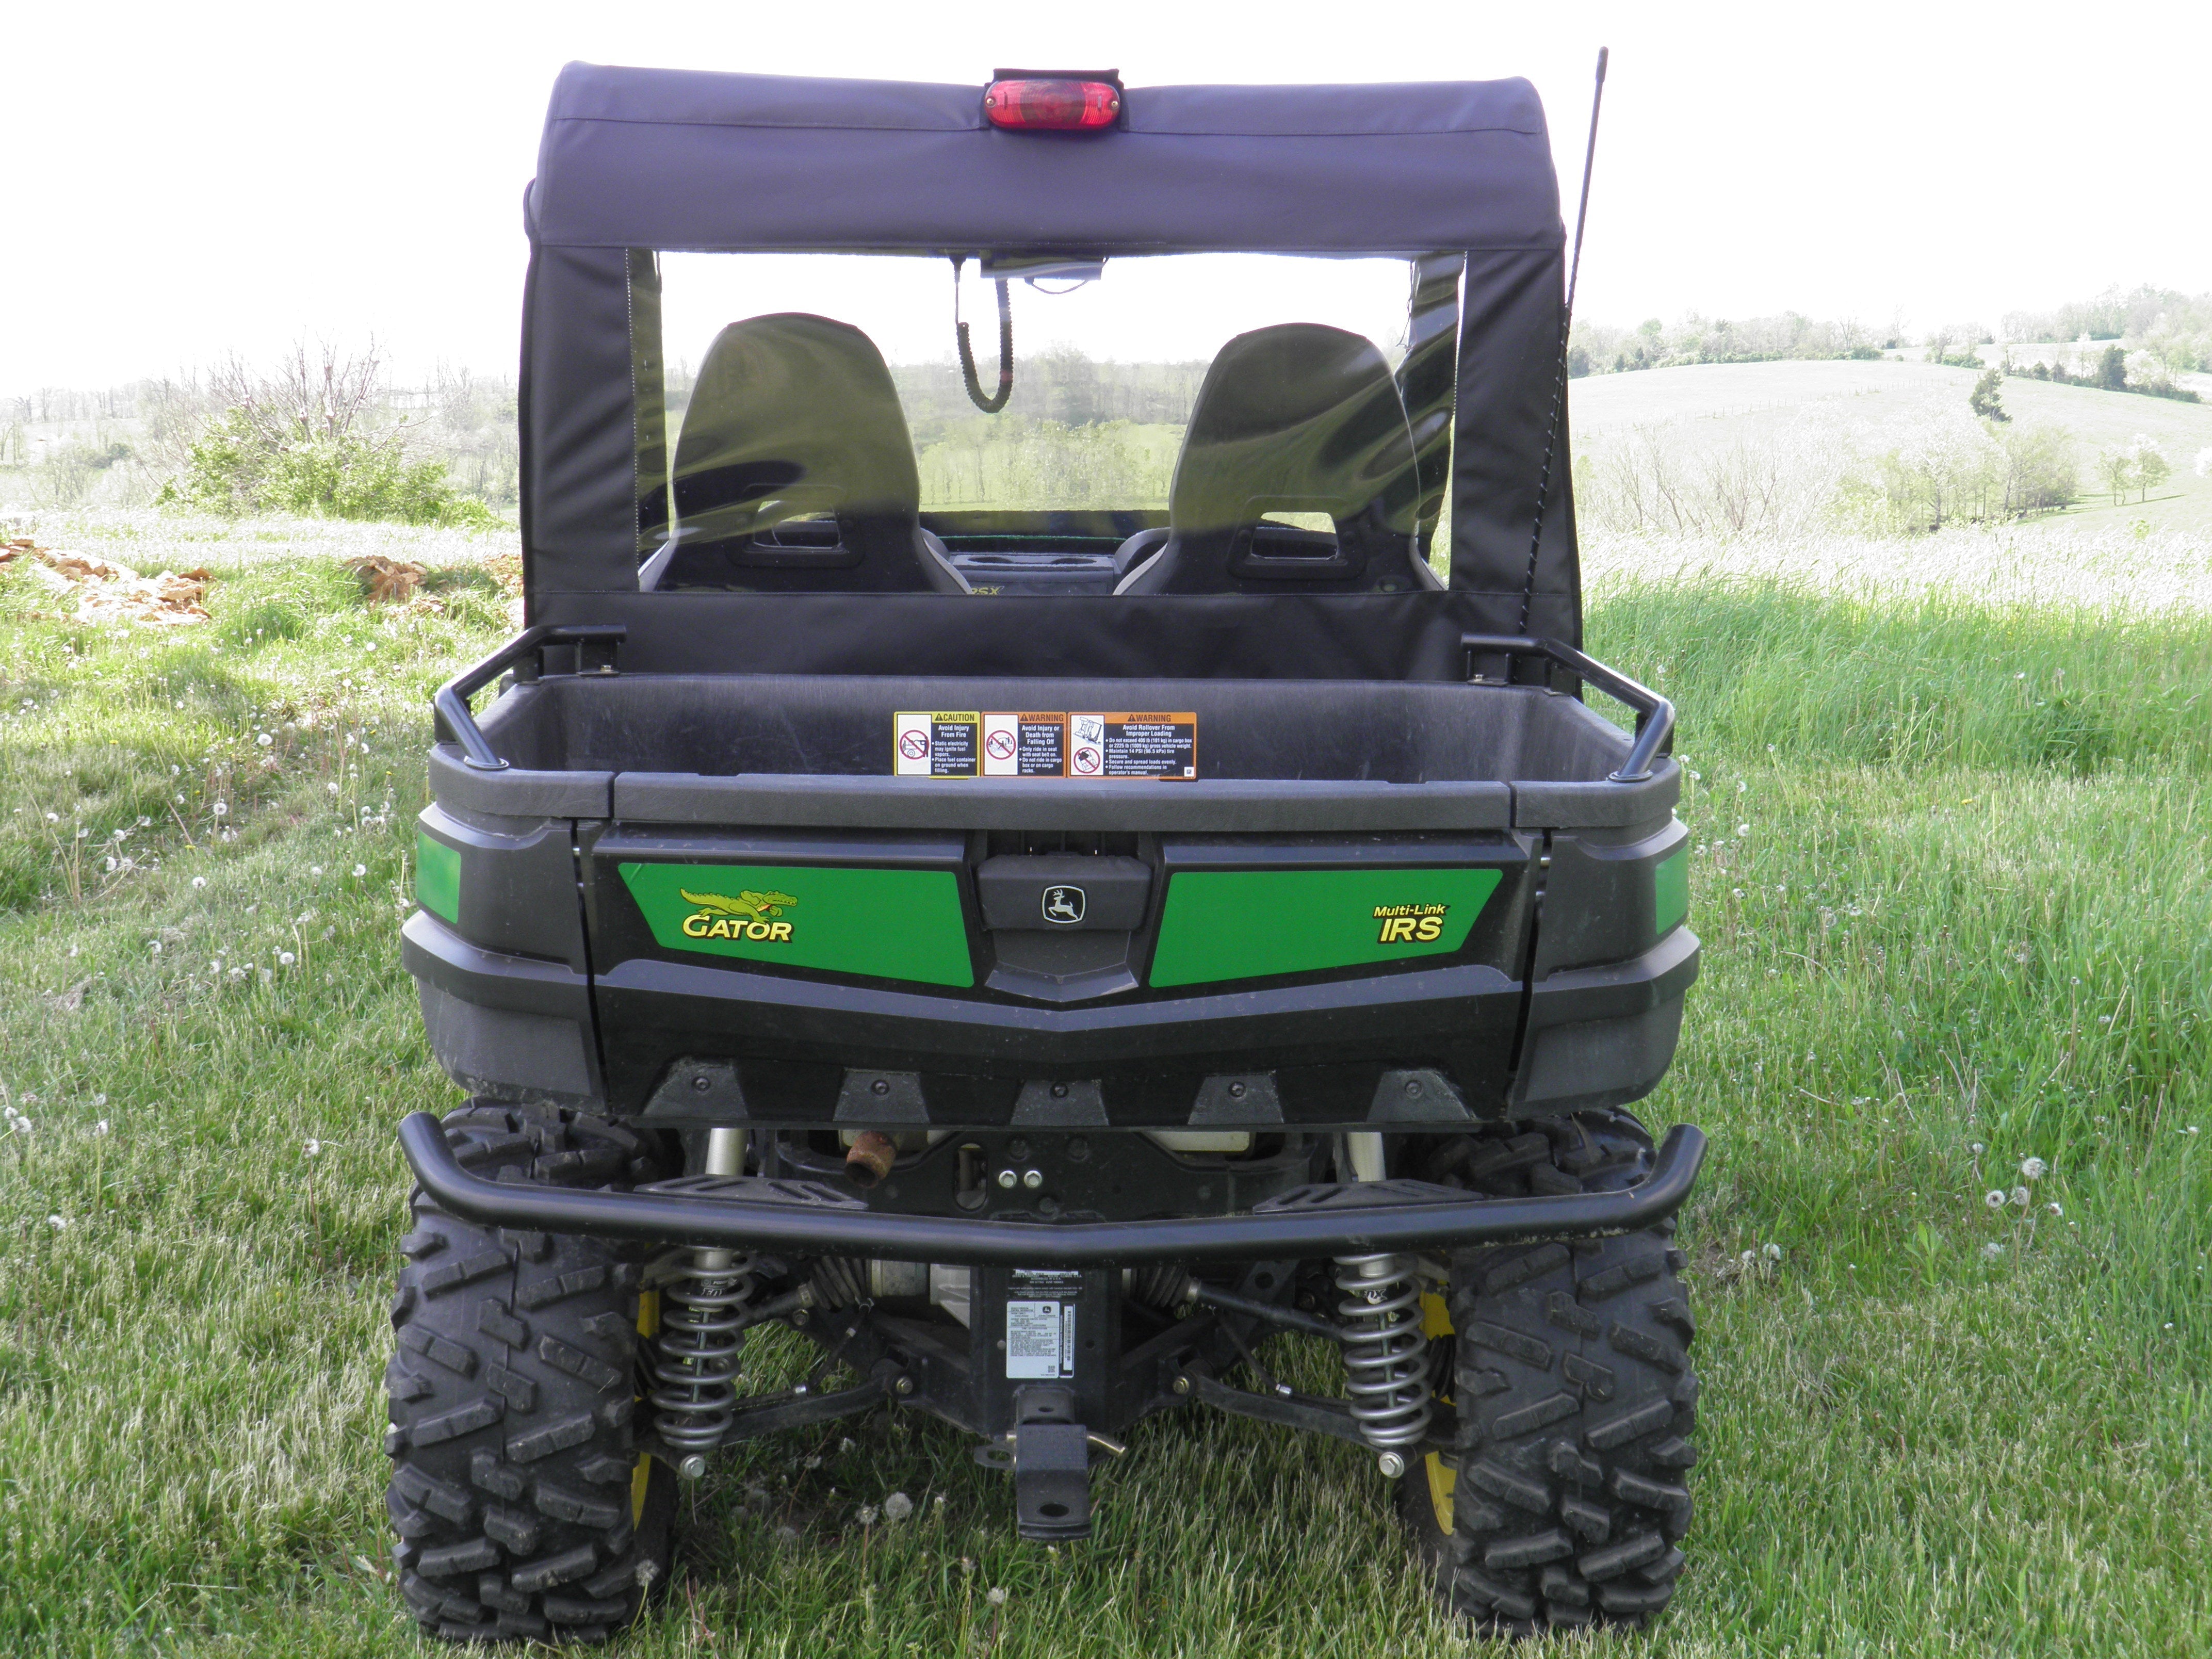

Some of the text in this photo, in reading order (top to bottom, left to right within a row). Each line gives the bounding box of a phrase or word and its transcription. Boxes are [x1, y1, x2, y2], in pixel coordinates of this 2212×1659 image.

[1374, 904, 1446, 917] Multi-Link
[683, 914, 792, 942] GATOR
[1380, 916, 1443, 942] IRS
